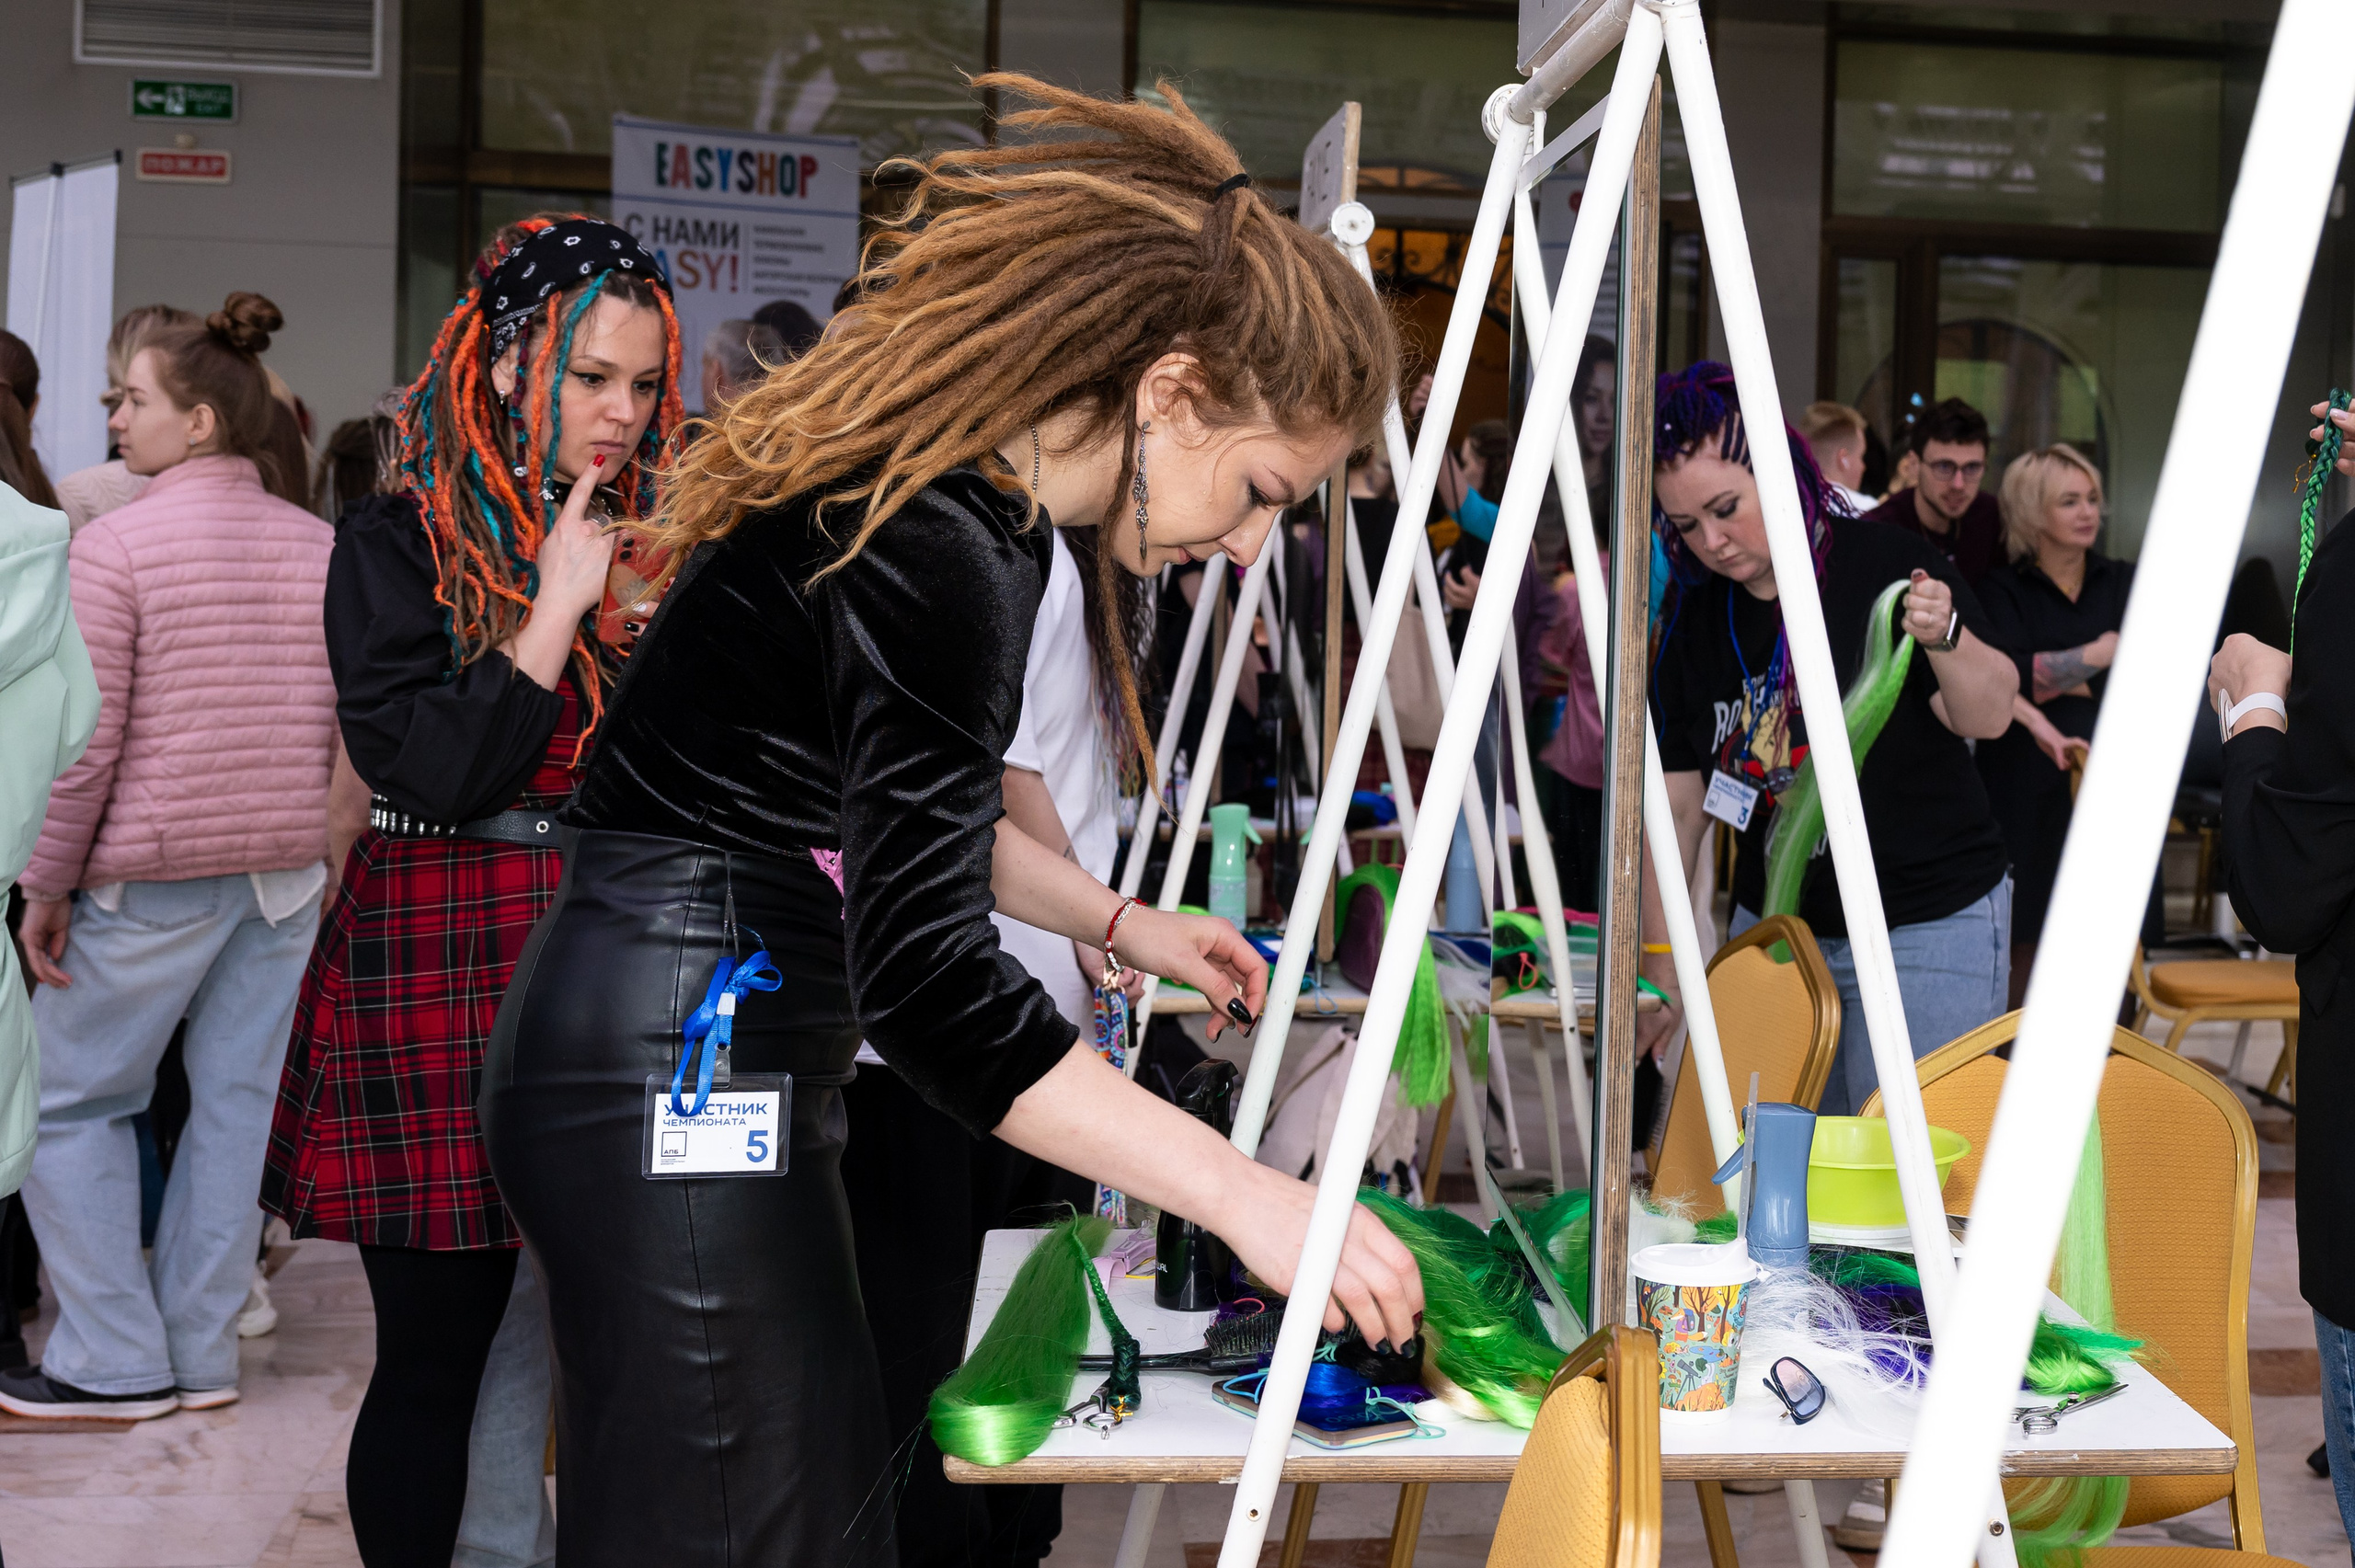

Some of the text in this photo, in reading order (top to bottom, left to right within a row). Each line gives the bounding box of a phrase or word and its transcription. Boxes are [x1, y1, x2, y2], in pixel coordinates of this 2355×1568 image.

[655, 141, 818, 199] EASYSHOP
[651, 214, 741, 250] НАМИ
[654, 248, 740, 293] ASY!
[1737, 806, 1750, 825] 3
[662, 1117, 747, 1127] ЧЕМПИОНАТА
[664, 1103, 769, 1116] УСТНИК
[745, 1129, 769, 1163] 5
